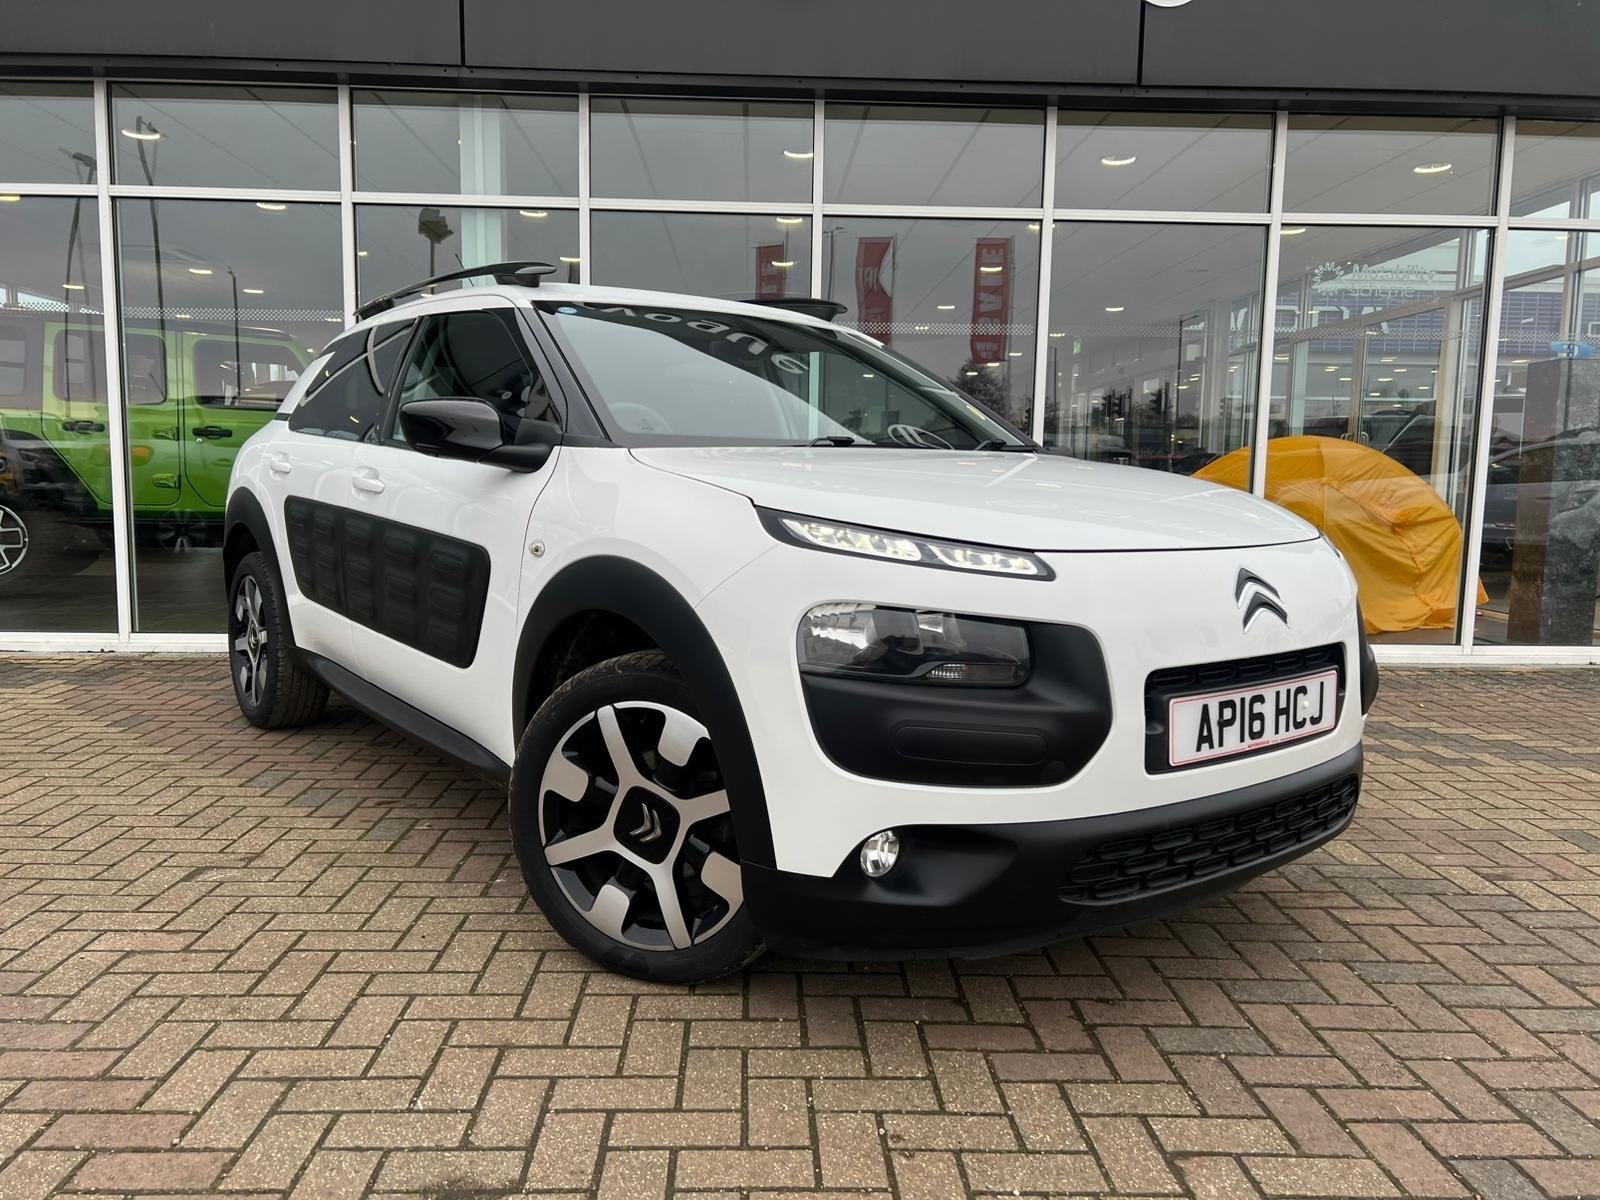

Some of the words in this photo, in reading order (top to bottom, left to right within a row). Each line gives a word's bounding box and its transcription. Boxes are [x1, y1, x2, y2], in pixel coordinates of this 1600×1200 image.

[1352, 263, 1438, 284] Motability
[1349, 281, 1415, 297] Scheme
[1196, 694, 1265, 752] AP16
[1275, 681, 1325, 735] HCJ
